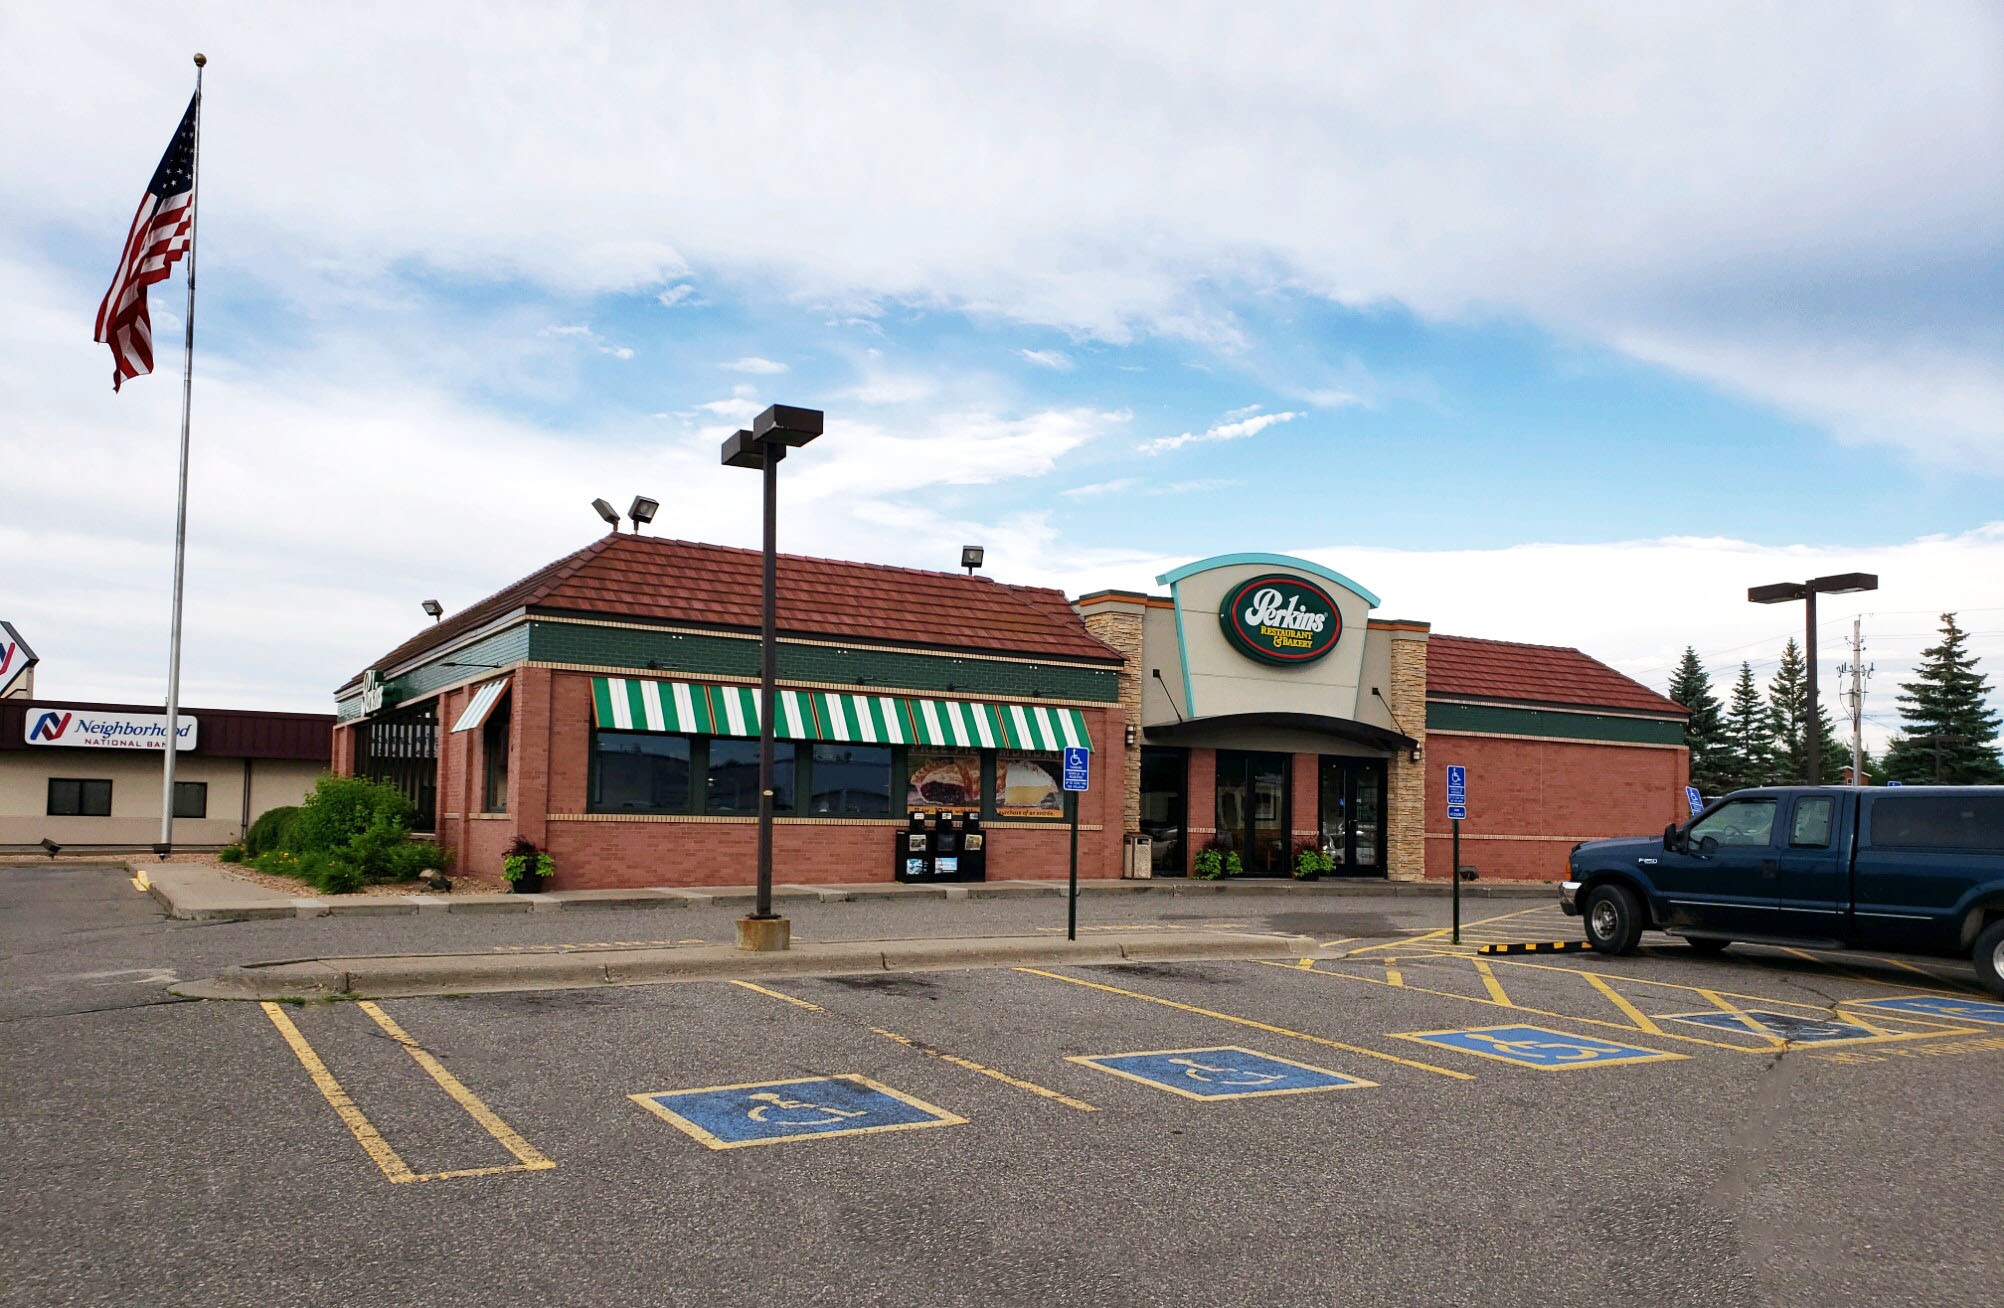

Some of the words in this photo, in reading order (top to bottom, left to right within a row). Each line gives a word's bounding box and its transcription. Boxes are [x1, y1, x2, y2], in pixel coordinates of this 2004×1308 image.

[1245, 588, 1326, 632] Perkins
[1261, 626, 1313, 639] RESTAURANT
[84, 738, 142, 747] NATIONAL
[146, 740, 167, 748] BAN
